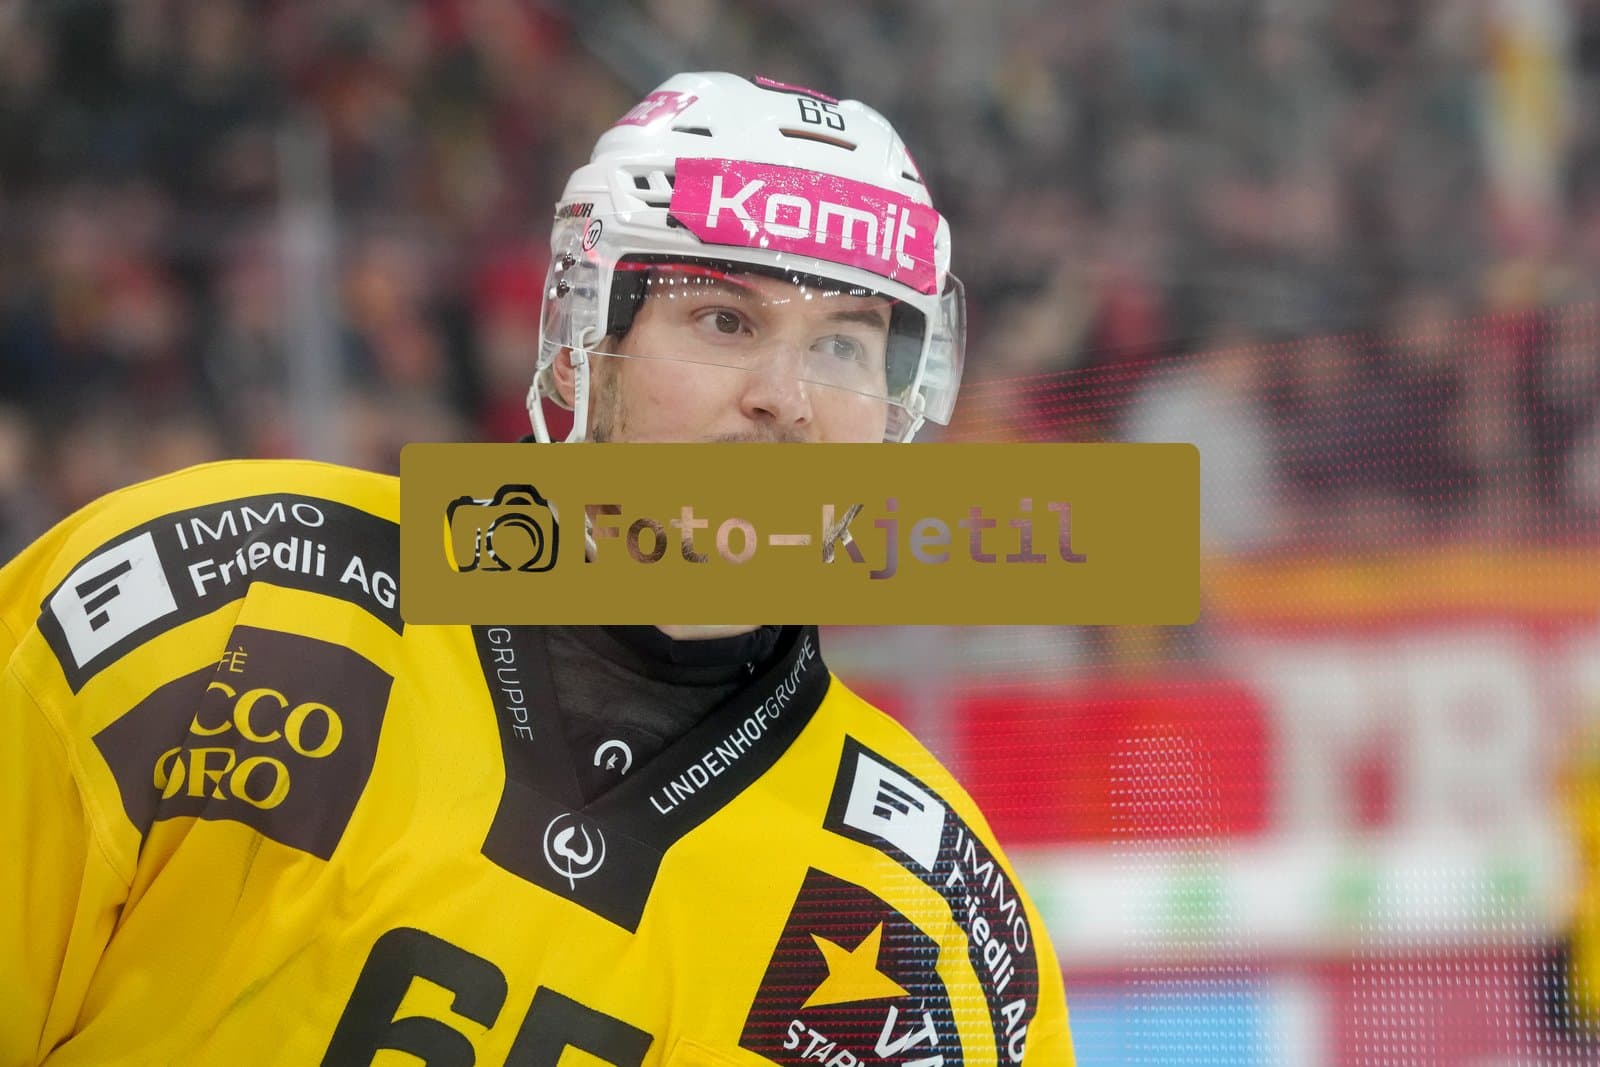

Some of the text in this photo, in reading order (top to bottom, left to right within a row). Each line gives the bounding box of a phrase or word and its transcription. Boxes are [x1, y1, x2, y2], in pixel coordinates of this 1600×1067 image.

[797, 98, 845, 131] 65
[705, 175, 922, 269] Komit
[174, 502, 325, 550] IMMO
[187, 536, 397, 609] Friedli AG
[189, 681, 343, 759] CCO
[649, 635, 816, 815] LINDENHOFGRUPPE
[955, 827, 1028, 953] IMMO
[783, 1019, 865, 1067] STAR
